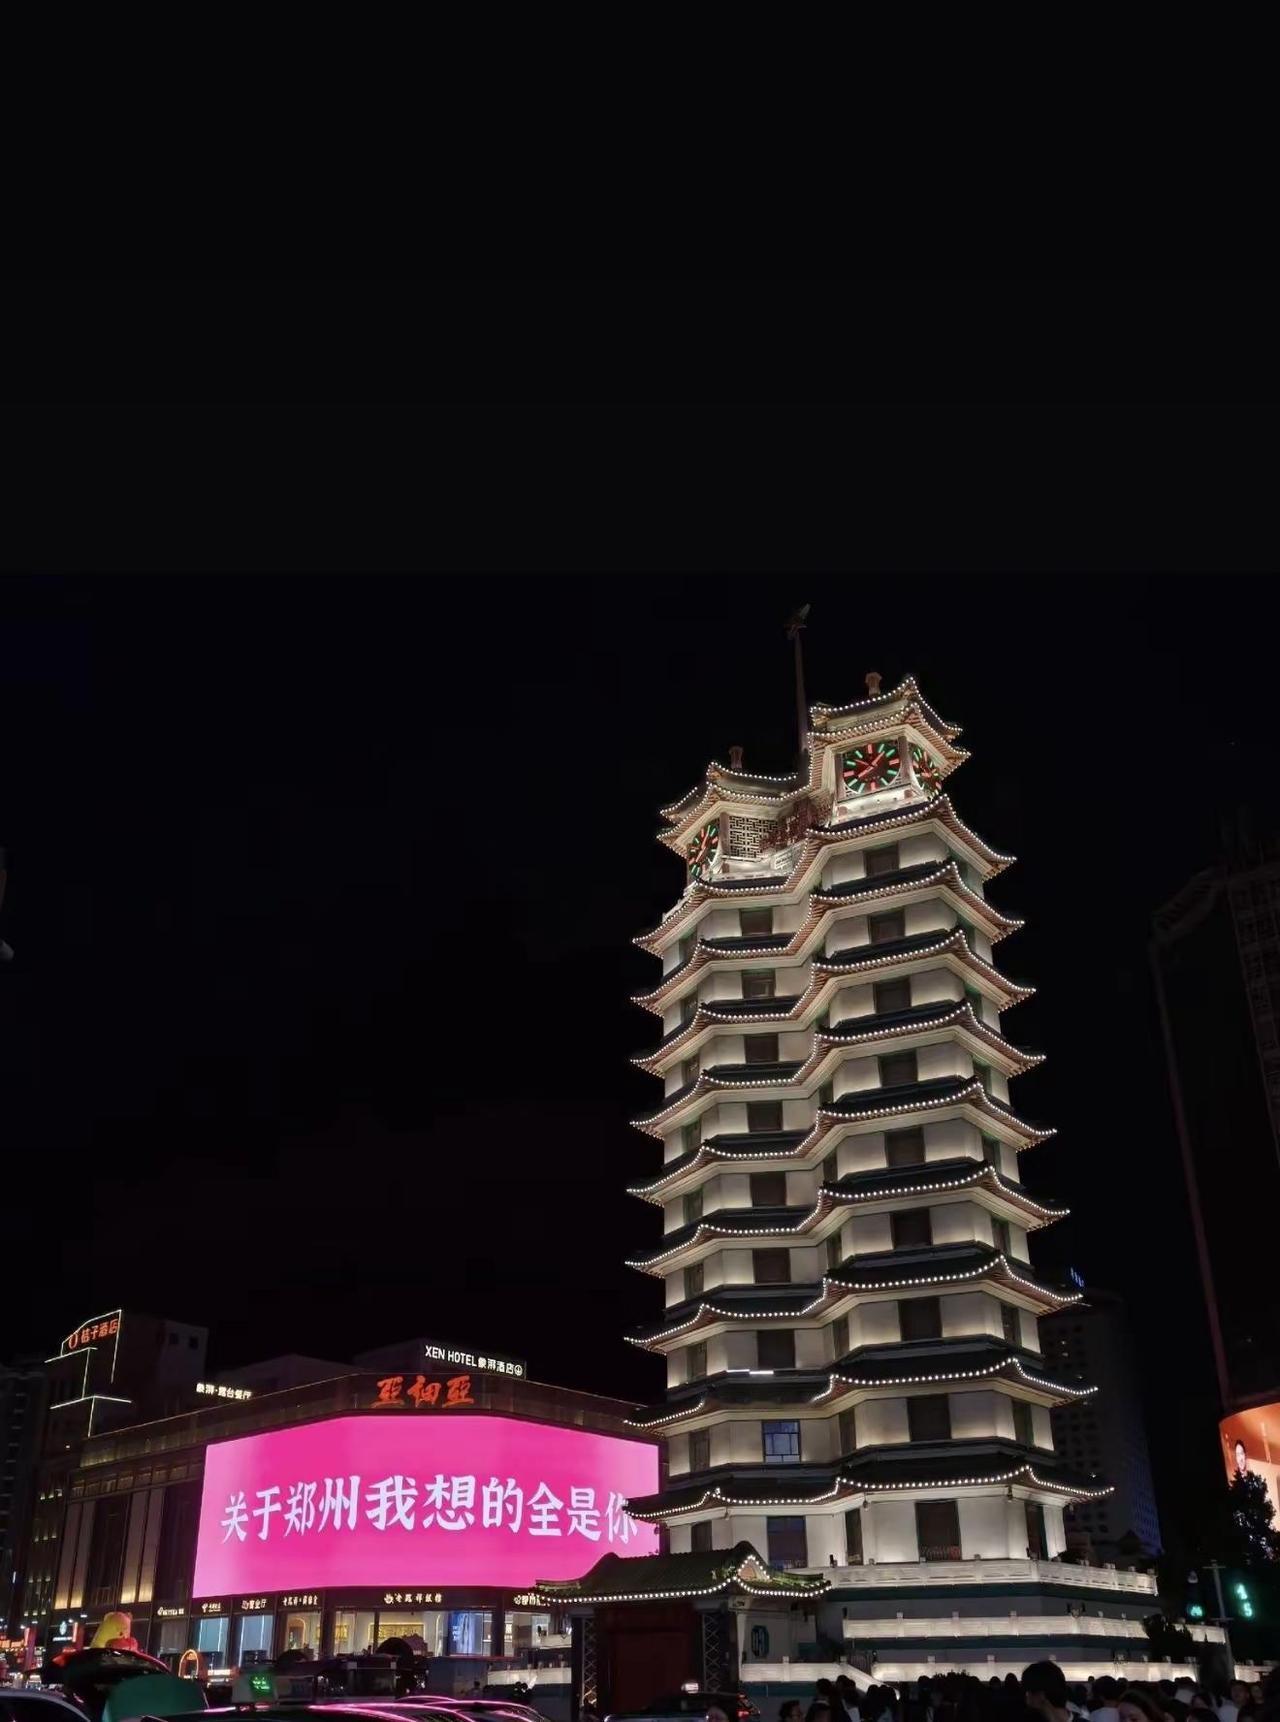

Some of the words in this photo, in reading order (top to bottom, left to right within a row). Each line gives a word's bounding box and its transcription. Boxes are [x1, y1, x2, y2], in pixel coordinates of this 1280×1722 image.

[425, 1345, 446, 1361] XEN
[447, 1350, 478, 1368] HOTEL
[221, 1474, 639, 1545] 关于郑州我想的全是你
